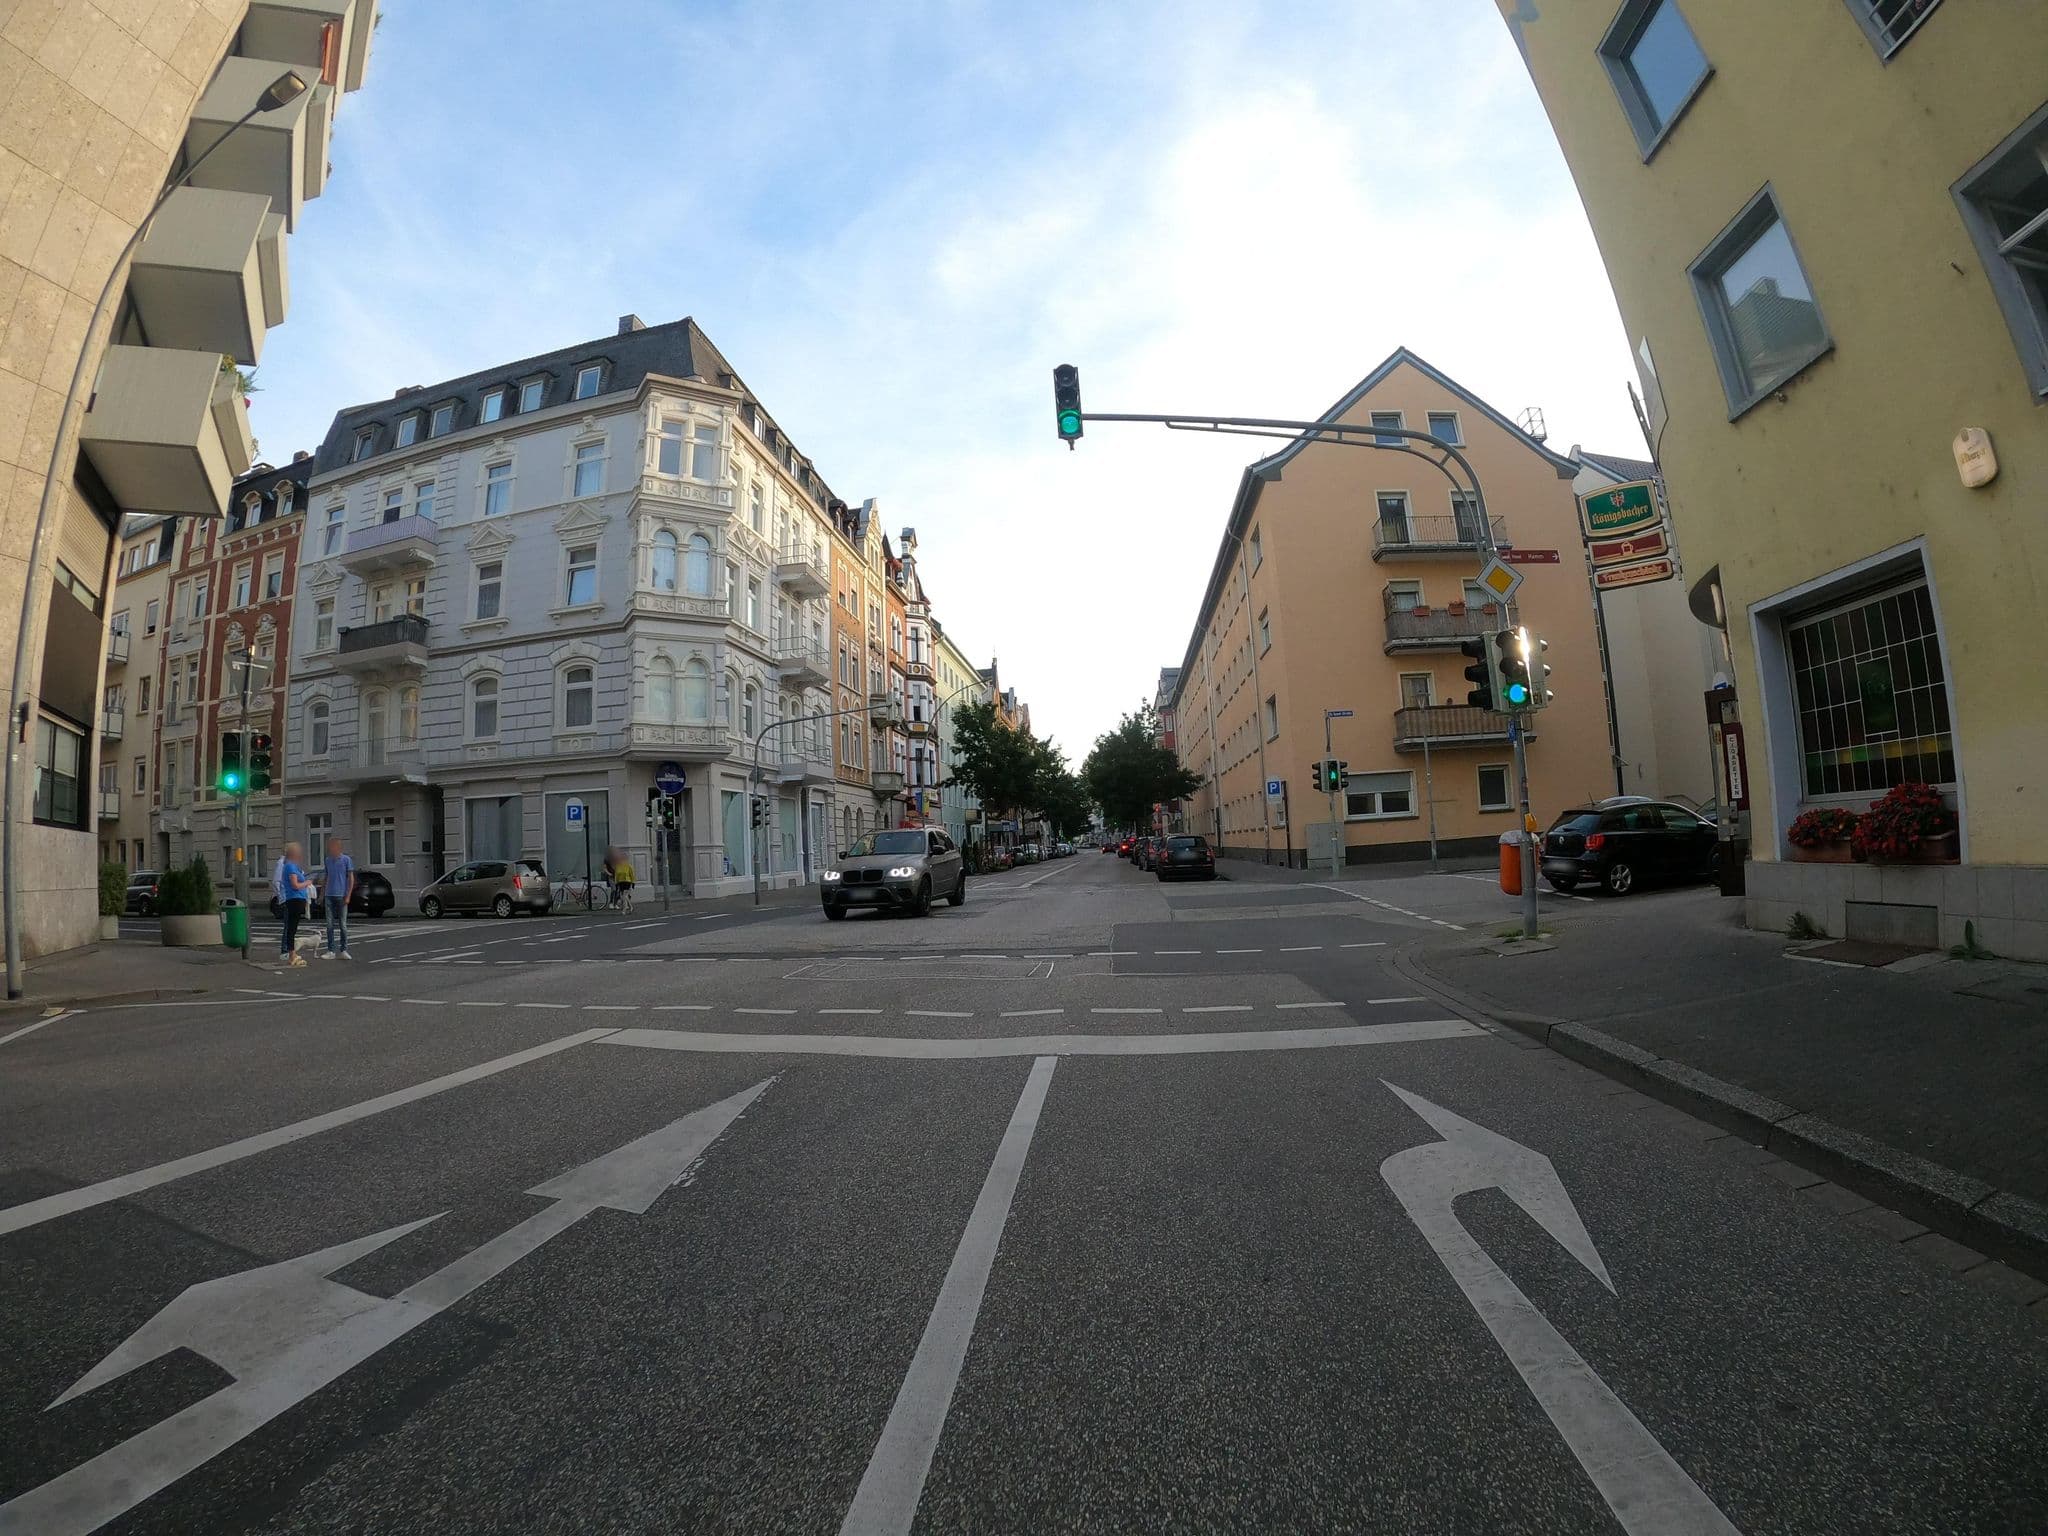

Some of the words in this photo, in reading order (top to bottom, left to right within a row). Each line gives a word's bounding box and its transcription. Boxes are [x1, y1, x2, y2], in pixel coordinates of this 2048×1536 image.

[1592, 504, 1649, 525] Königsbacher
[1270, 783, 1277, 793] P
[570, 807, 579, 819] P
